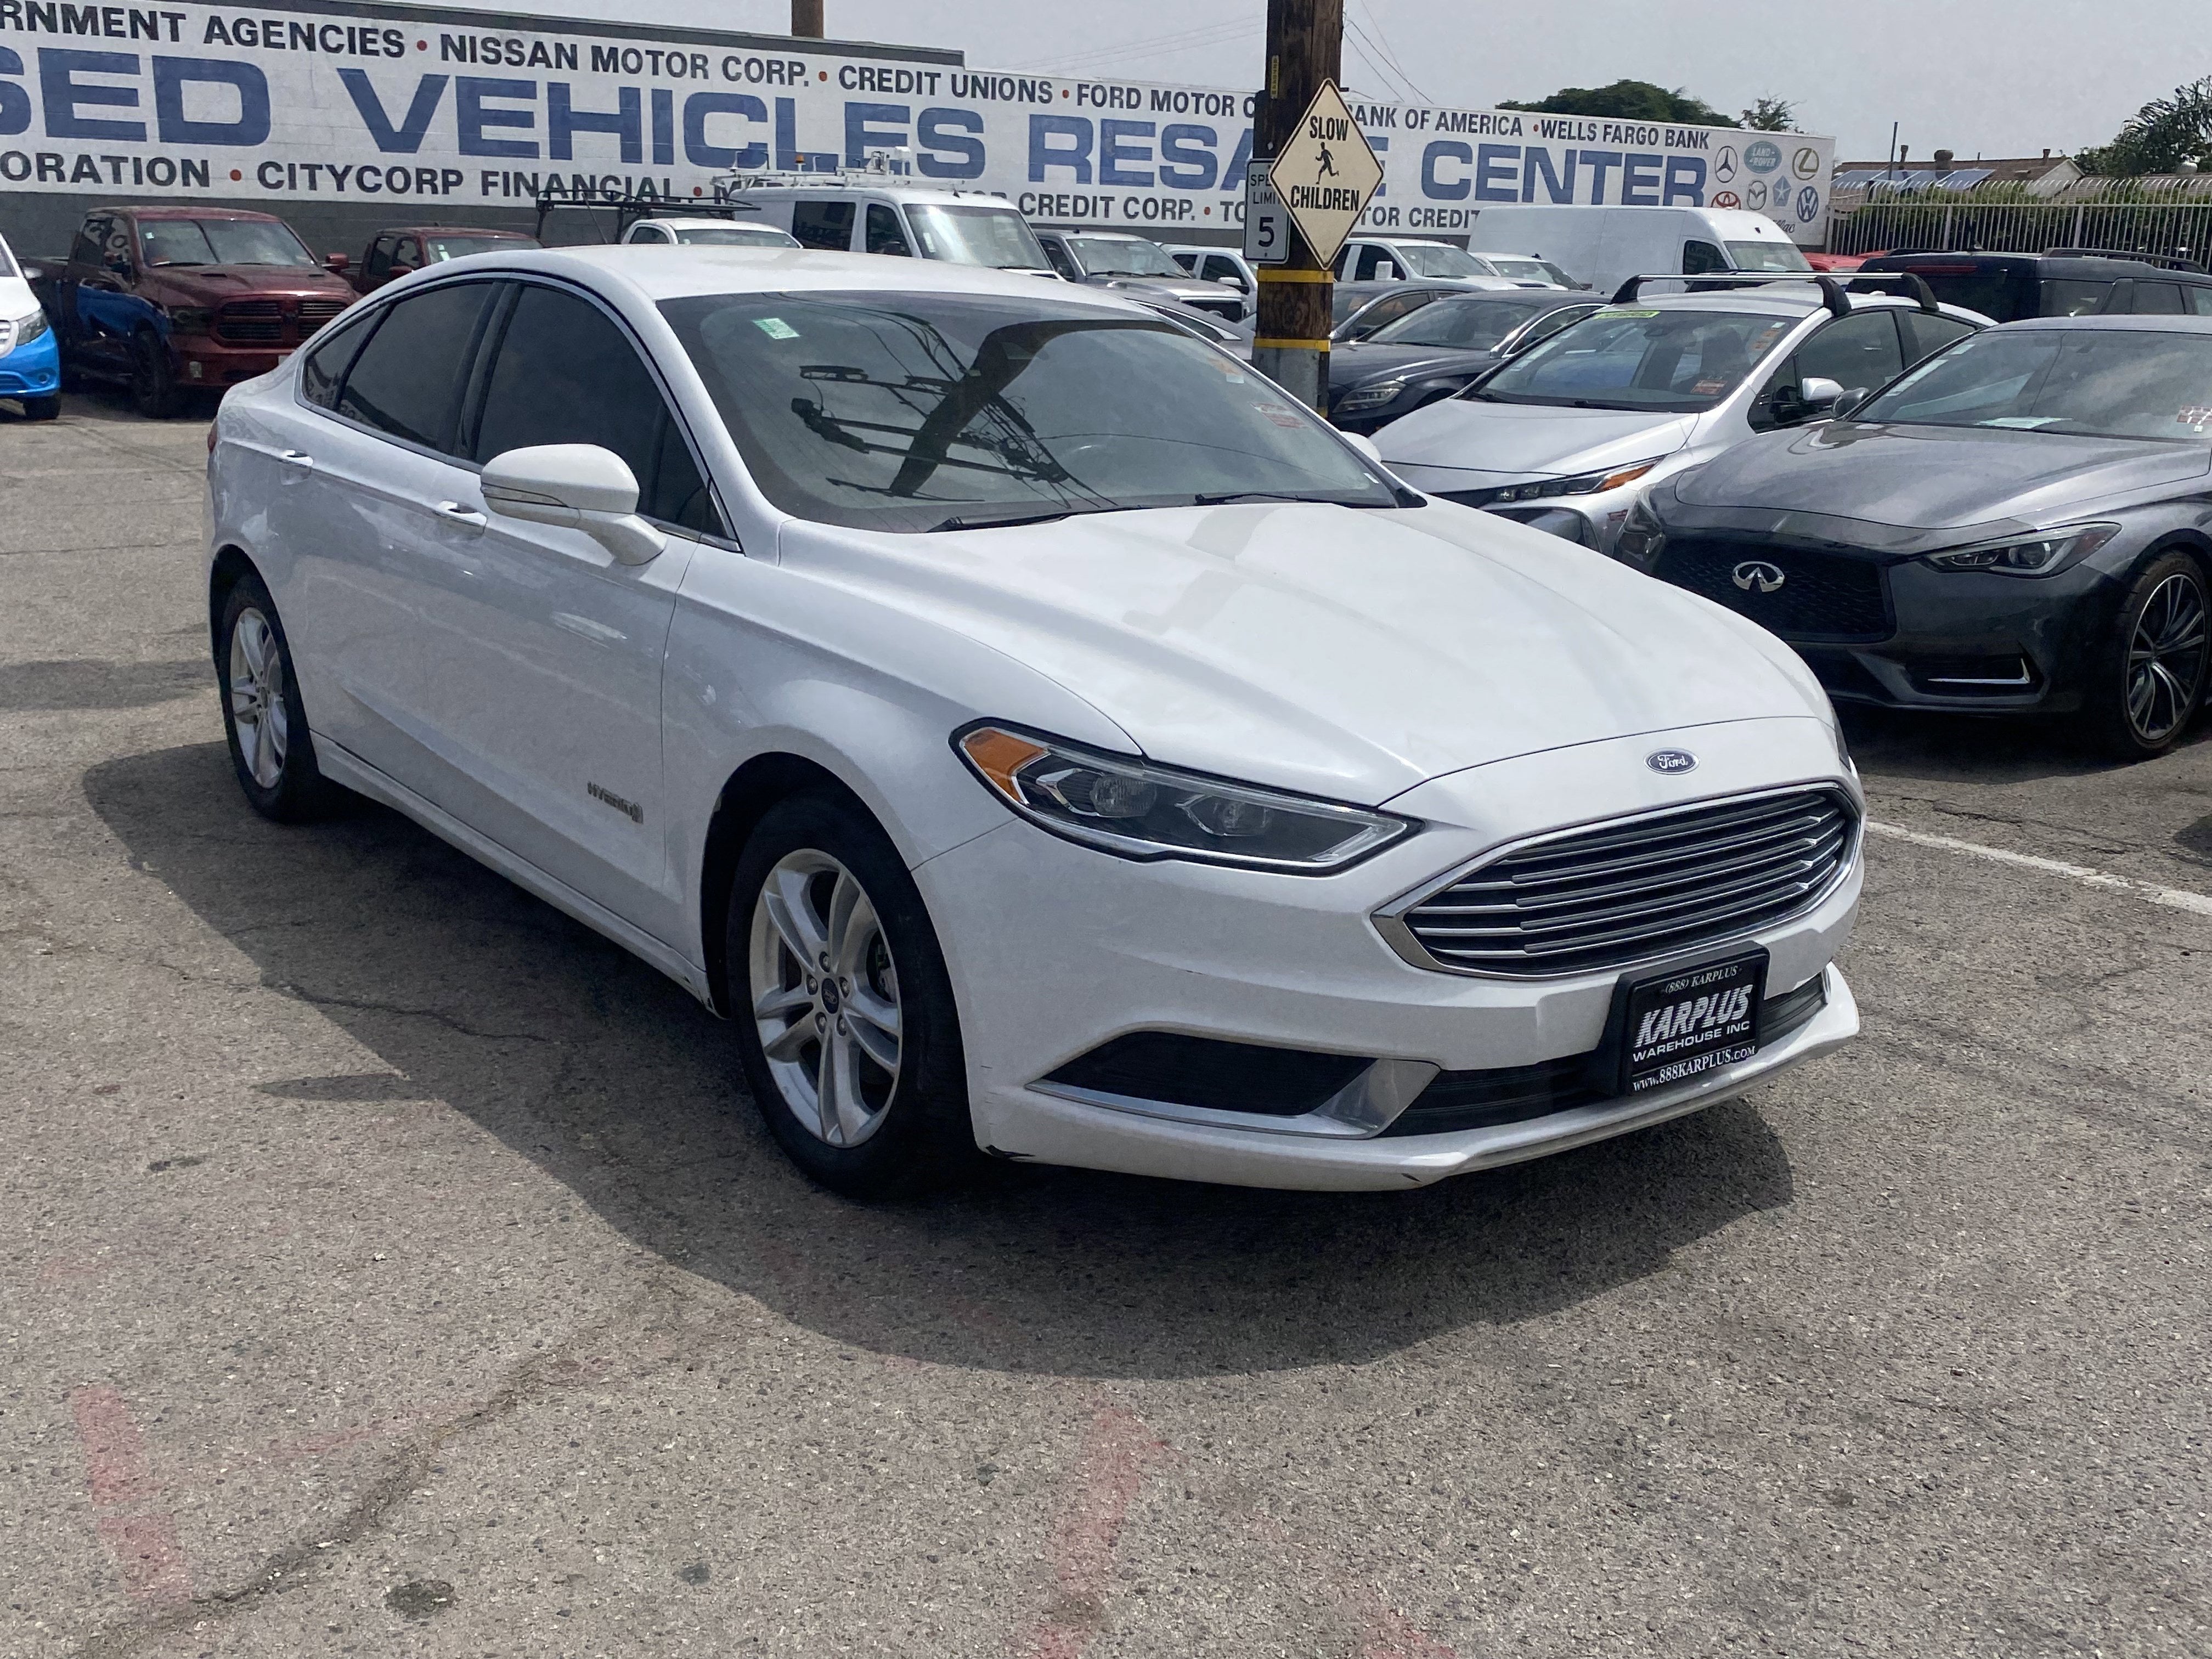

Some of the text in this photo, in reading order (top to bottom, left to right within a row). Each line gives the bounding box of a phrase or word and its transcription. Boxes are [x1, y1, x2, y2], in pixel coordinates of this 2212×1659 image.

[203, 15, 405, 58] AGENCIES
[440, 33, 809, 87] NISSAN MOTOR CORP.
[839, 65, 1053, 104] CREDIT UNIONS
[1077, 83, 1142, 109] FORD
[1150, 89, 1234, 117] MOTOR
[336, 68, 985, 179] VEHICLES
[1421, 140, 1707, 206] CENTER
[1309, 115, 1349, 141] SLOW
[1347, 104, 1523, 137] ANK OF AMERICA
[1541, 120, 1709, 149] WELLS FARGO BANK
[0, 150, 210, 187] ORATION
[257, 161, 464, 195] CITYCORP
[481, 170, 681, 202] FINANCIAL
[1250, 174, 1271, 187] SPE
[1018, 193, 1115, 218] CREDIT
[1123, 197, 1195, 221] CORP.
[1290, 185, 1360, 211] CHILDREN
[1258, 217, 1274, 247] 5
[1361, 207, 1480, 228] TOR CREDIT
[1657, 753, 1689, 769] Ford
[1665, 965, 1739, 995] (888) KARPLUS
[1633, 984, 1753, 1048] KARPLUS
[1633, 1020, 1751, 1062] WAREHOUSE INC
